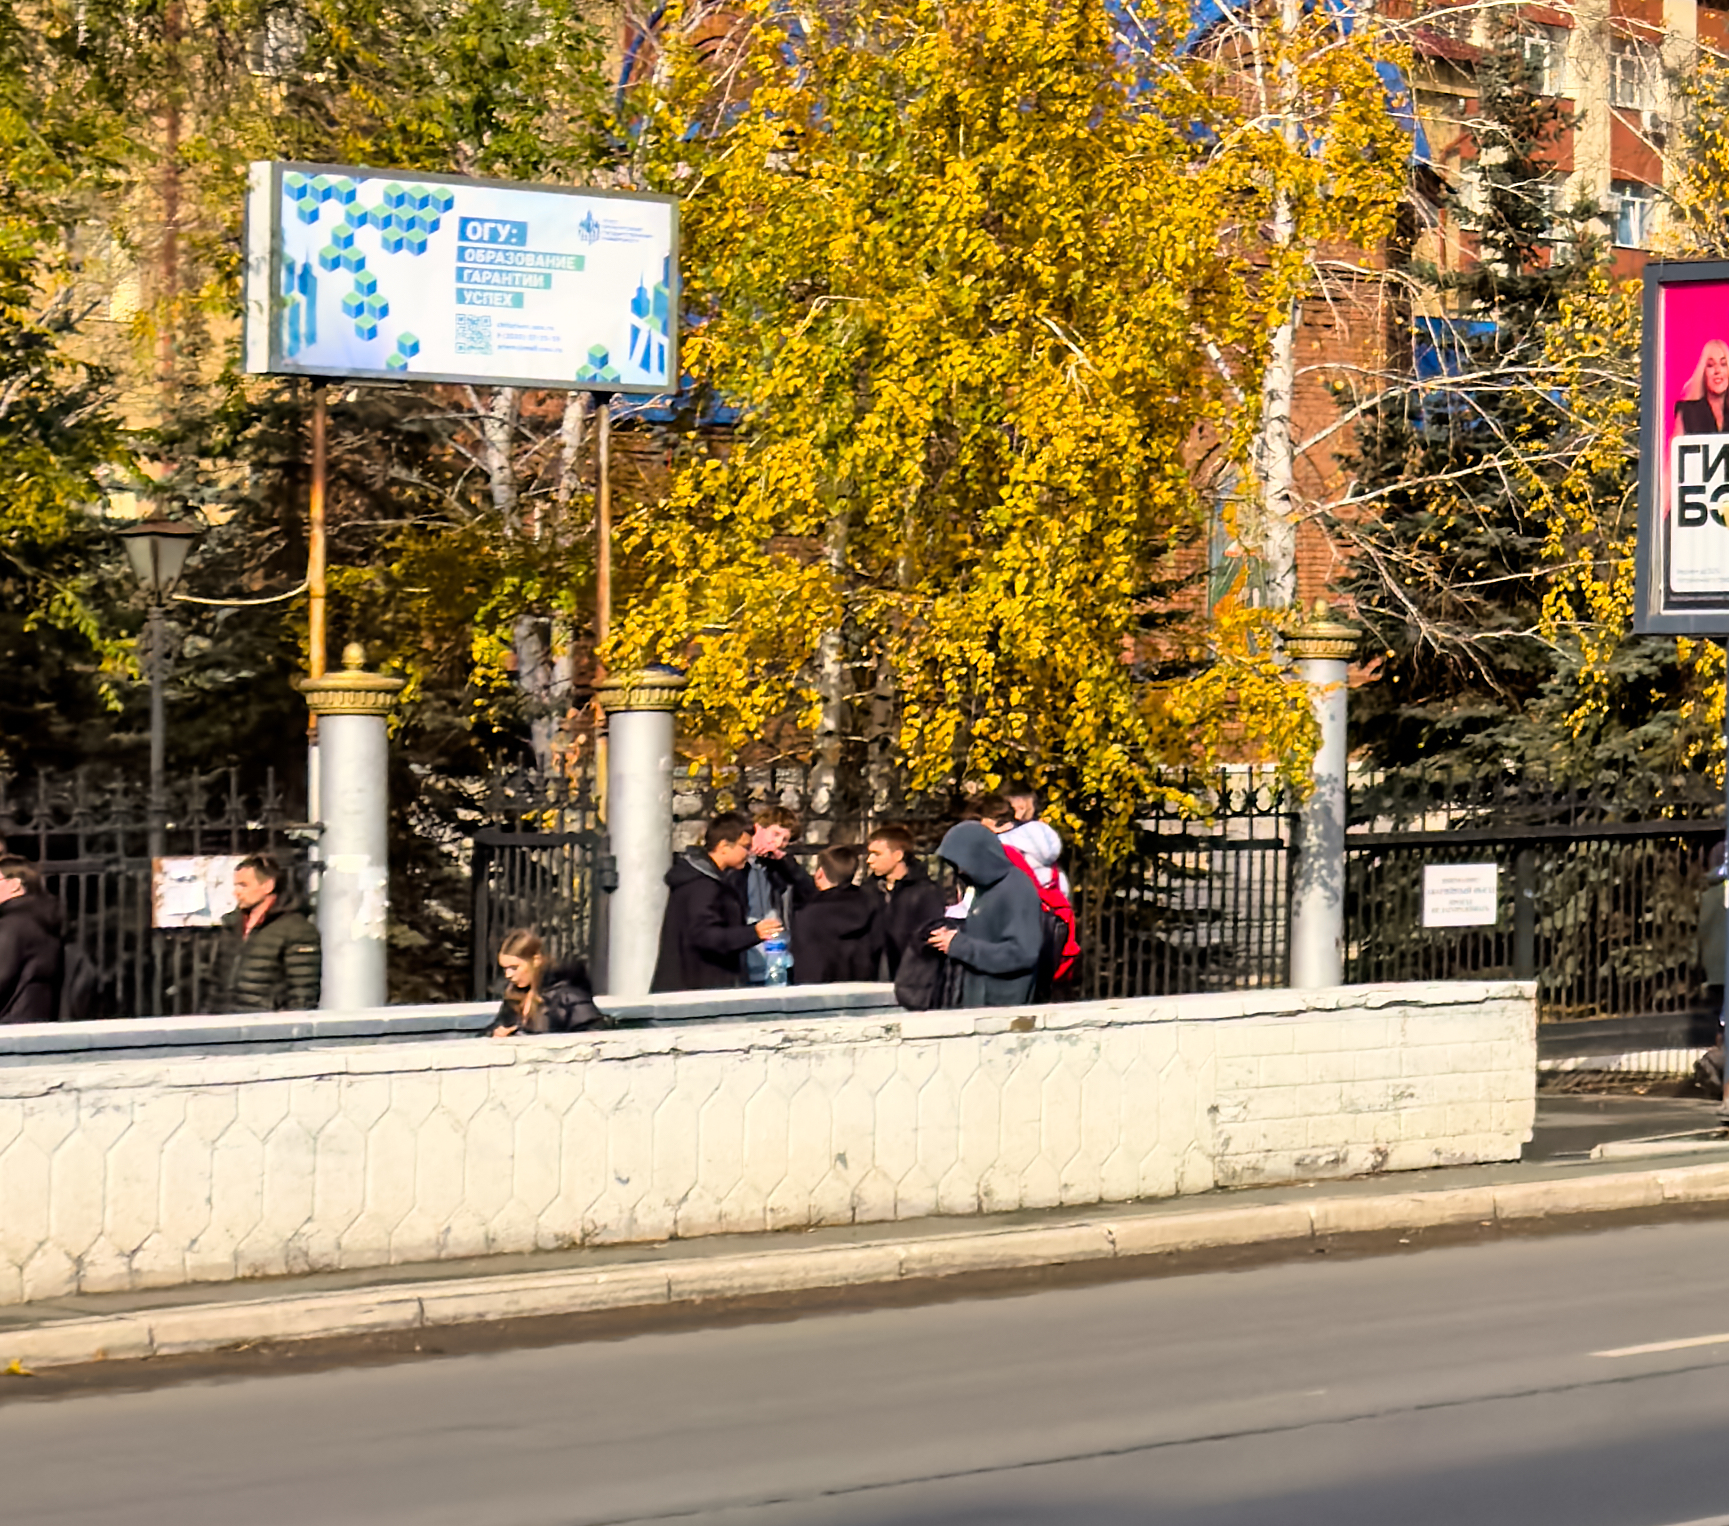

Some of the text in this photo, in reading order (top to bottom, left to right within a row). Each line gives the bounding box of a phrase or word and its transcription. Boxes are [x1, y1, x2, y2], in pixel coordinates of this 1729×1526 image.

[465, 221, 518, 244] ОГУ:
[464, 248, 577, 270] ОБРАЗОВАНИЕ
[462, 269, 545, 288] ГАРАНТИИ
[462, 290, 514, 307] УСПЕХ
